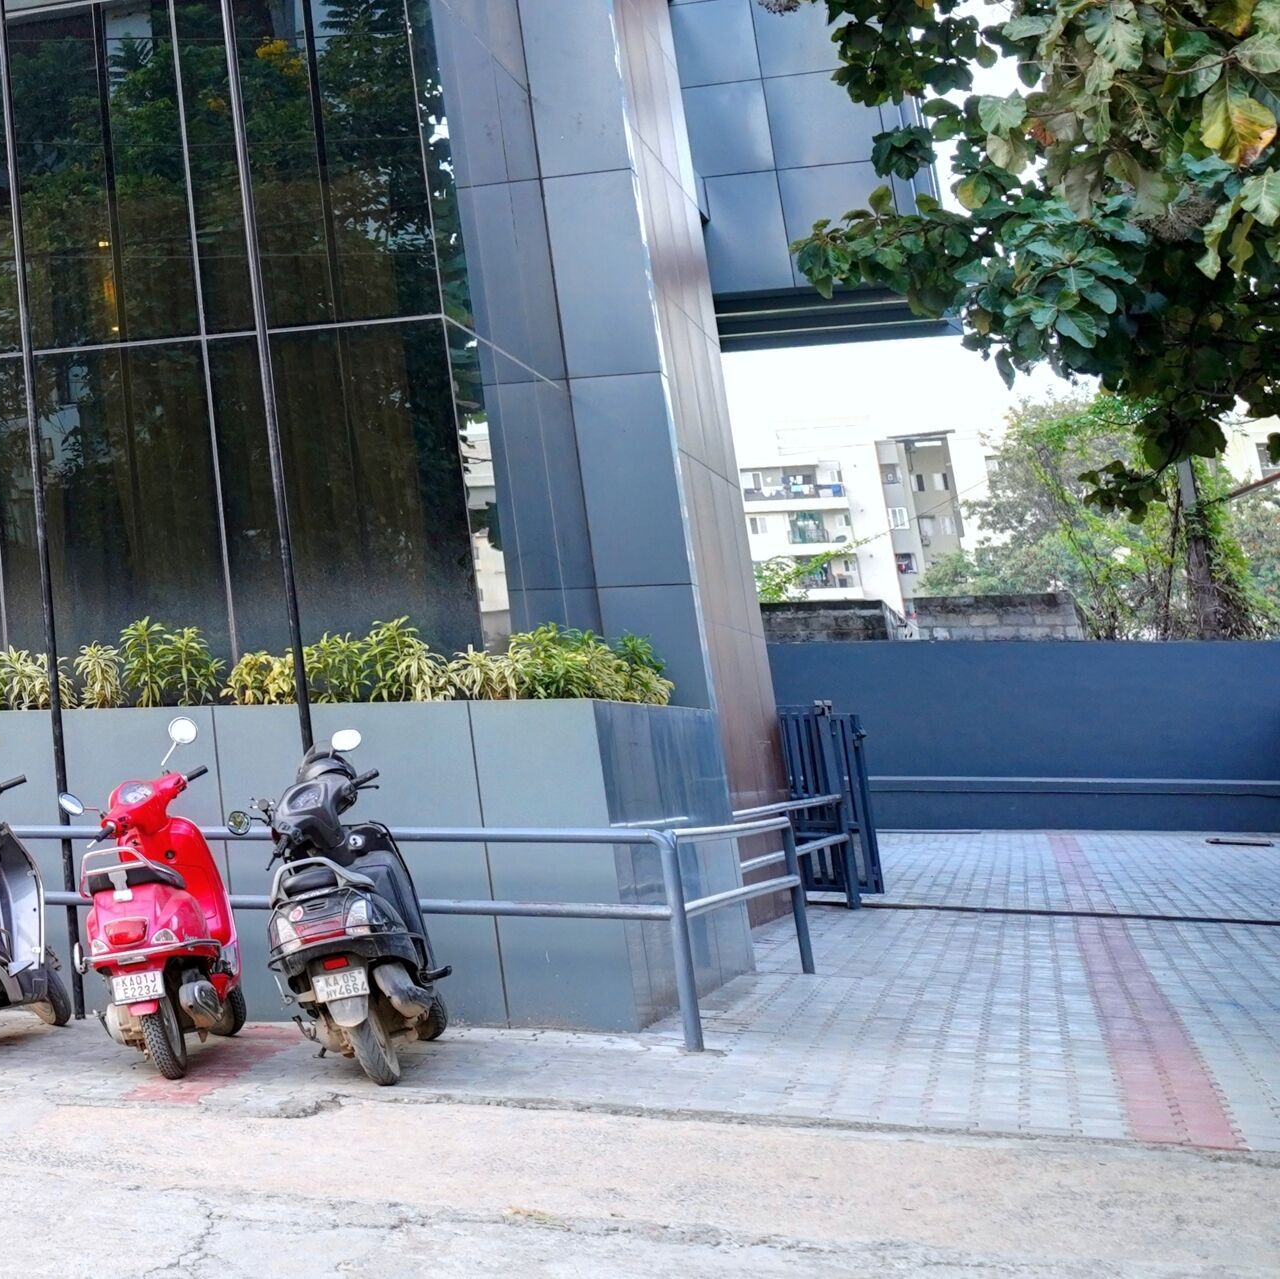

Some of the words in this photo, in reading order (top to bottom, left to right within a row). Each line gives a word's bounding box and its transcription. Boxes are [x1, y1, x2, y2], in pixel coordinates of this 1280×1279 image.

[121, 972, 157, 988] KA01J
[324, 976, 339, 988] KA
[341, 971, 357, 984] 05
[123, 984, 159, 999] E2234
